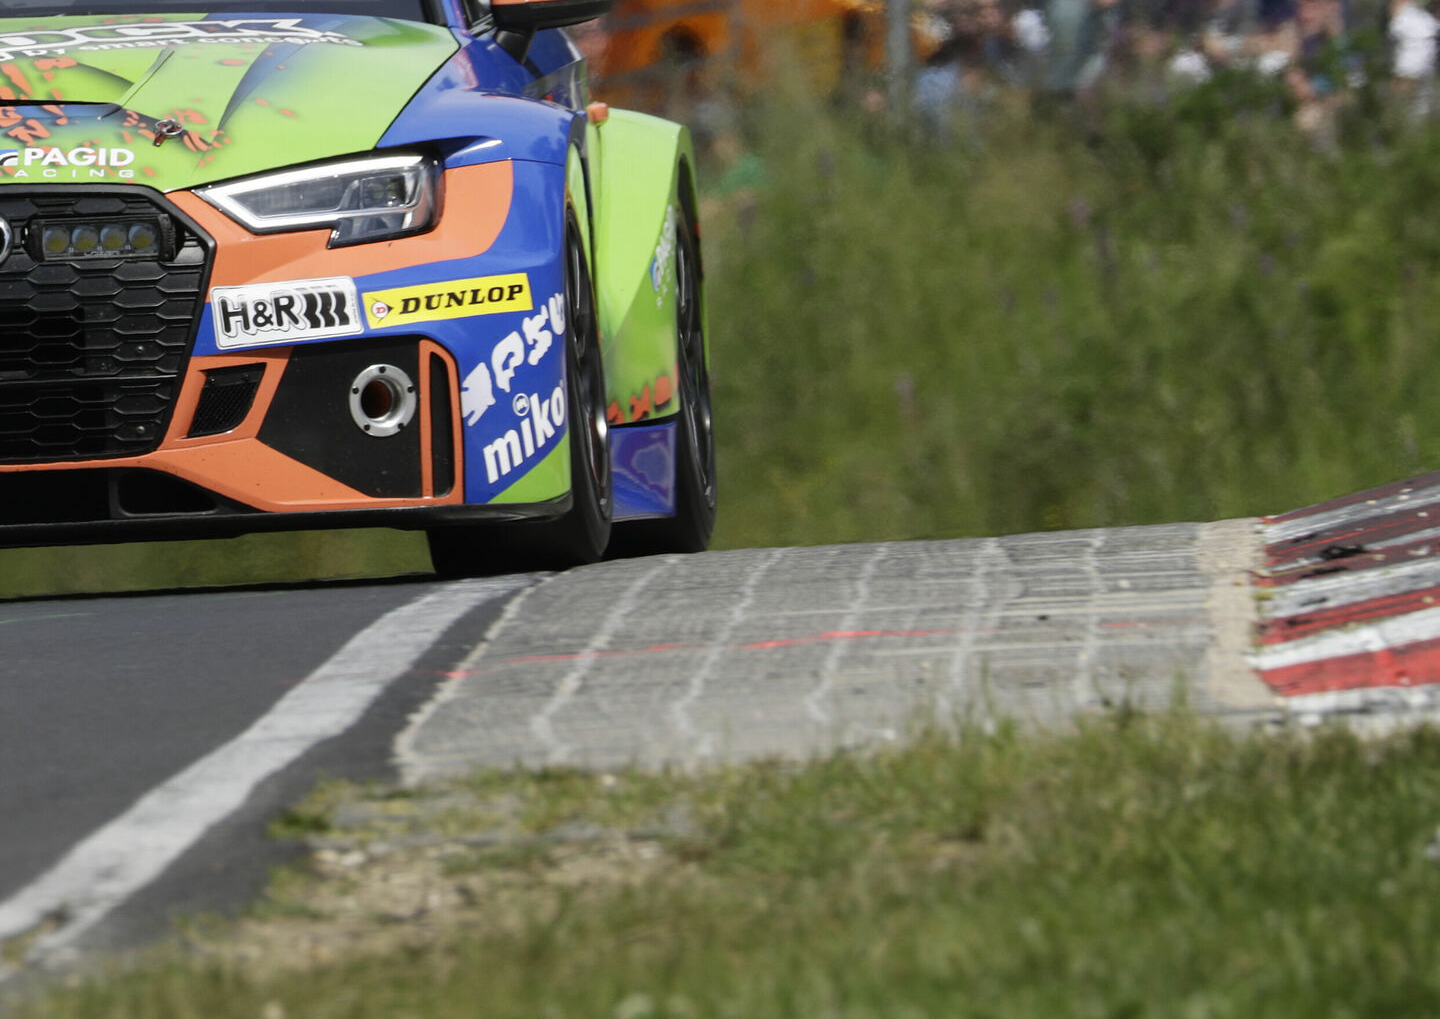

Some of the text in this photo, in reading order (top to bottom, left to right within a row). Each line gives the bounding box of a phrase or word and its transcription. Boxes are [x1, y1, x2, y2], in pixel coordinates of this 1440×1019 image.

[77, 38, 189, 52] smart
[24, 148, 135, 166] PAGID
[220, 293, 300, 333] H&R
[399, 284, 524, 315] DUNLOP
[482, 386, 565, 484] miko
